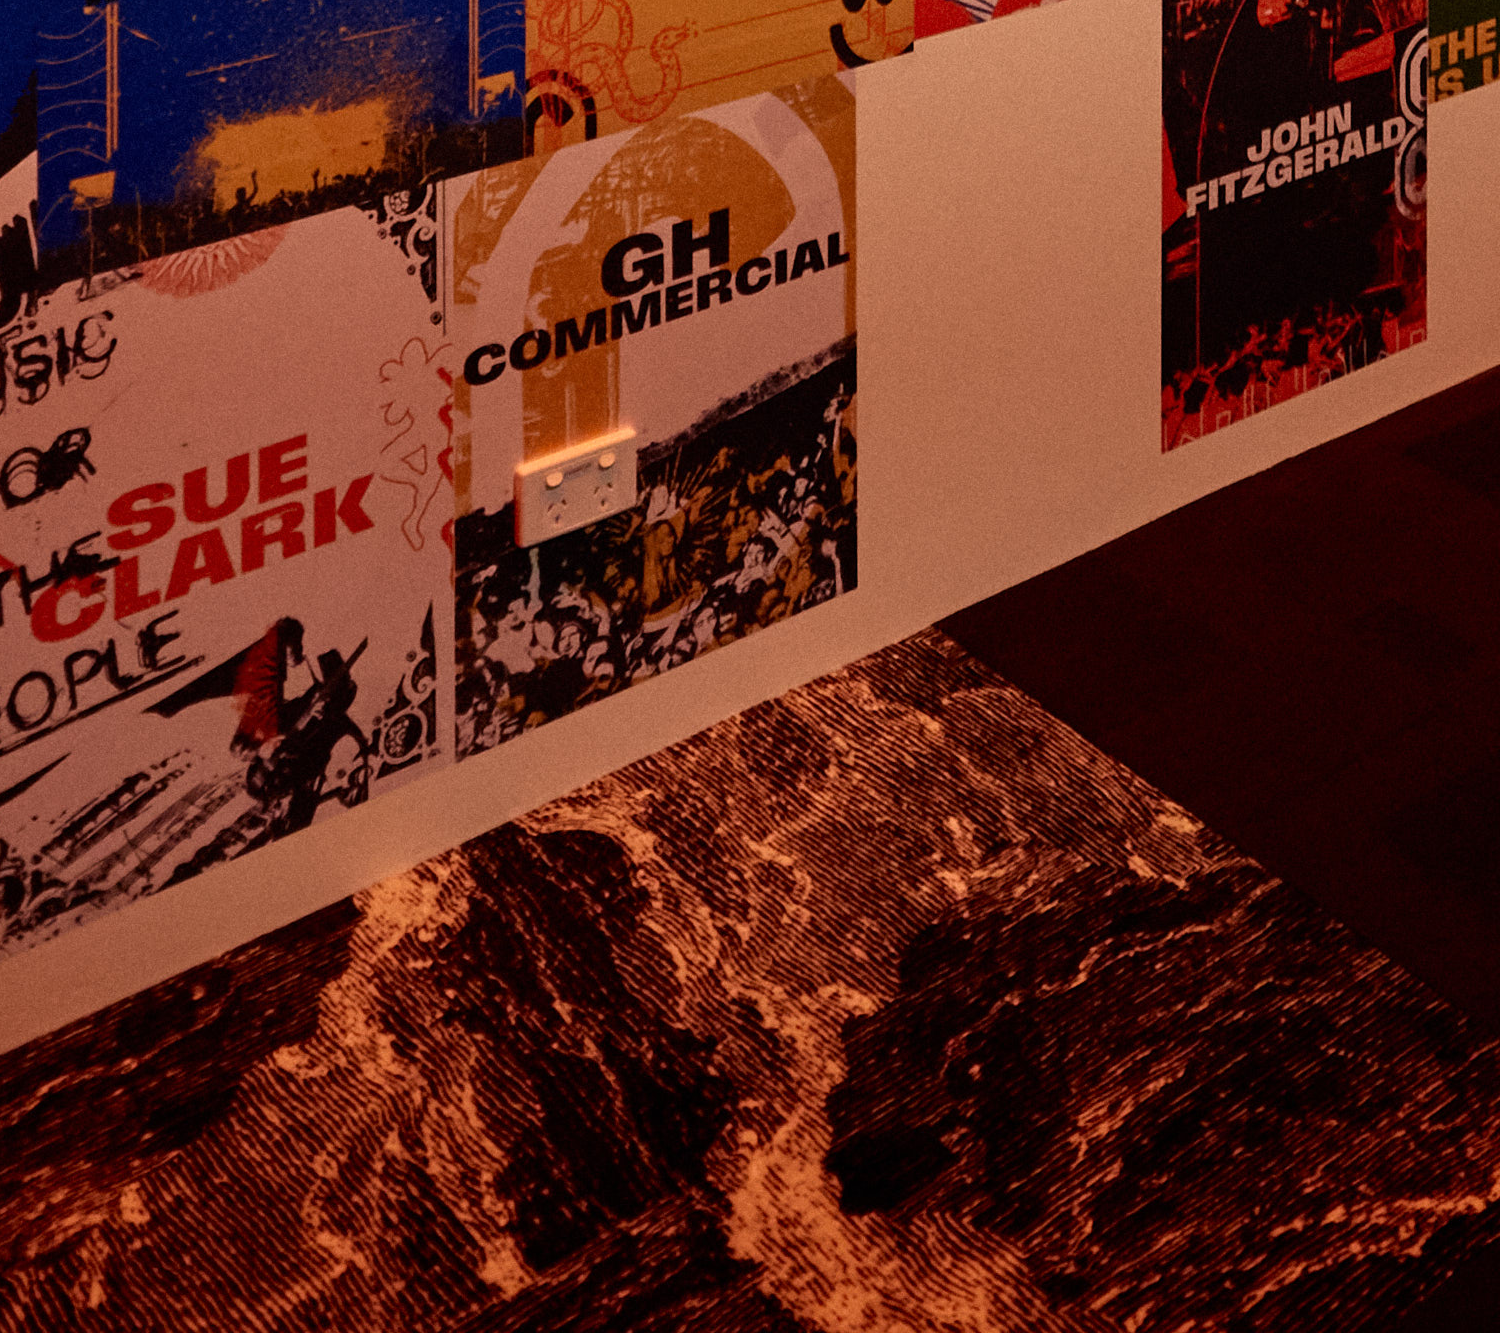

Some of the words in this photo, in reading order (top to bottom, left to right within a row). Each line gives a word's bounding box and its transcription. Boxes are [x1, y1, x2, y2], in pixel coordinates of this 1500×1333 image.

[1430, 18, 1497, 71] THE
[1185, 114, 1408, 218] FITZGERALD
[1246, 102, 1353, 163] JOHN
[601, 207, 730, 298] GH
[463, 232, 850, 386] COMMERCIAL
[106, 435, 308, 551] SUE
[31, 473, 374, 643] CLARK
